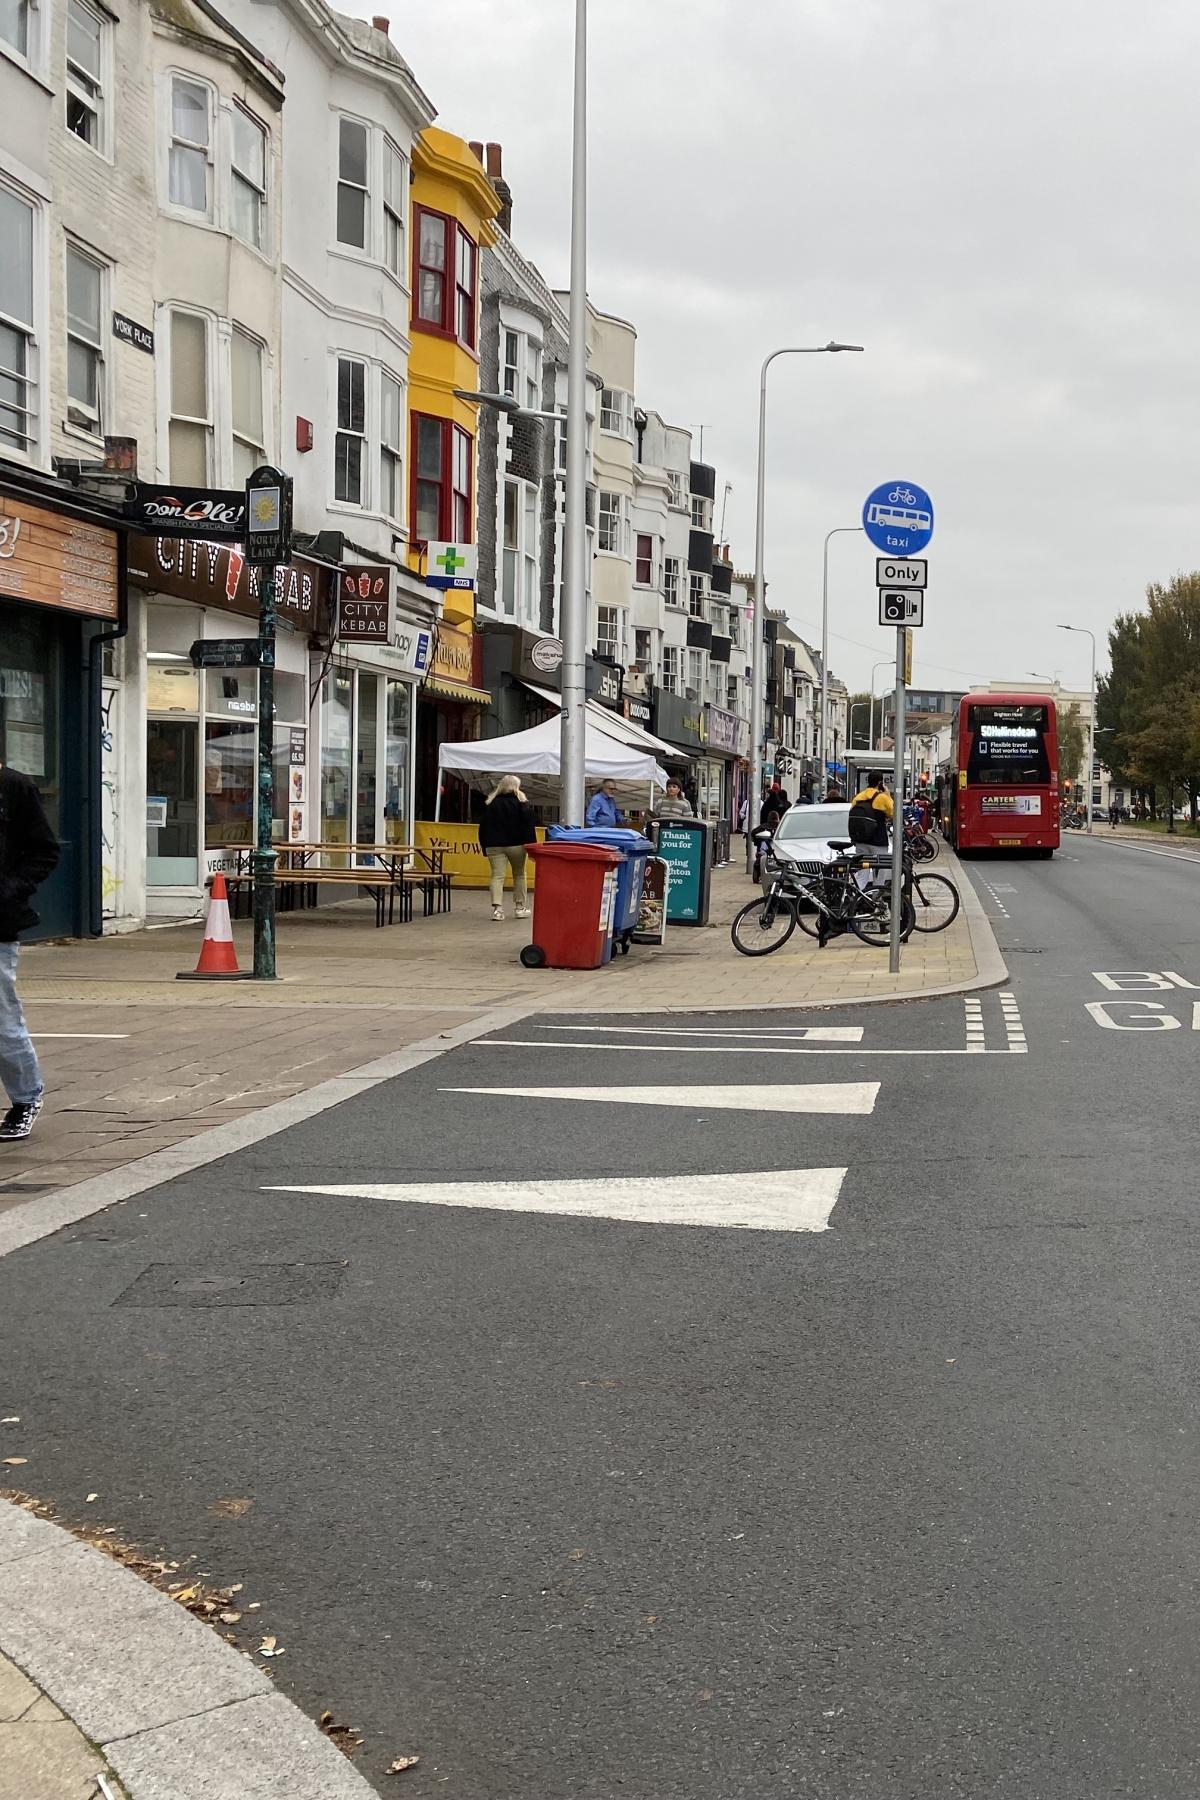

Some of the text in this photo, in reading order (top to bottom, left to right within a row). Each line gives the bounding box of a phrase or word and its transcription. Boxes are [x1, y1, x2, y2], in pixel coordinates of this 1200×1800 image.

[114, 317, 152, 349] YORK PLACE
[143, 501, 245, 524] Don Olé!
[152, 518, 178, 527] SPANISH
[178, 521, 198, 529] FOOD
[250, 534, 280, 545] NORTH
[887, 535, 909, 548] taxi
[252, 547, 277, 558] LAINE
[156, 536, 312, 613] CITY KBAB
[884, 565, 920, 582] Only
[344, 603, 383, 617] CITY
[340, 619, 387, 632] KEBAB
[662, 830, 691, 840] Thank
[429, 837, 483, 856] YELLOW
[661, 840, 692, 849] you for
